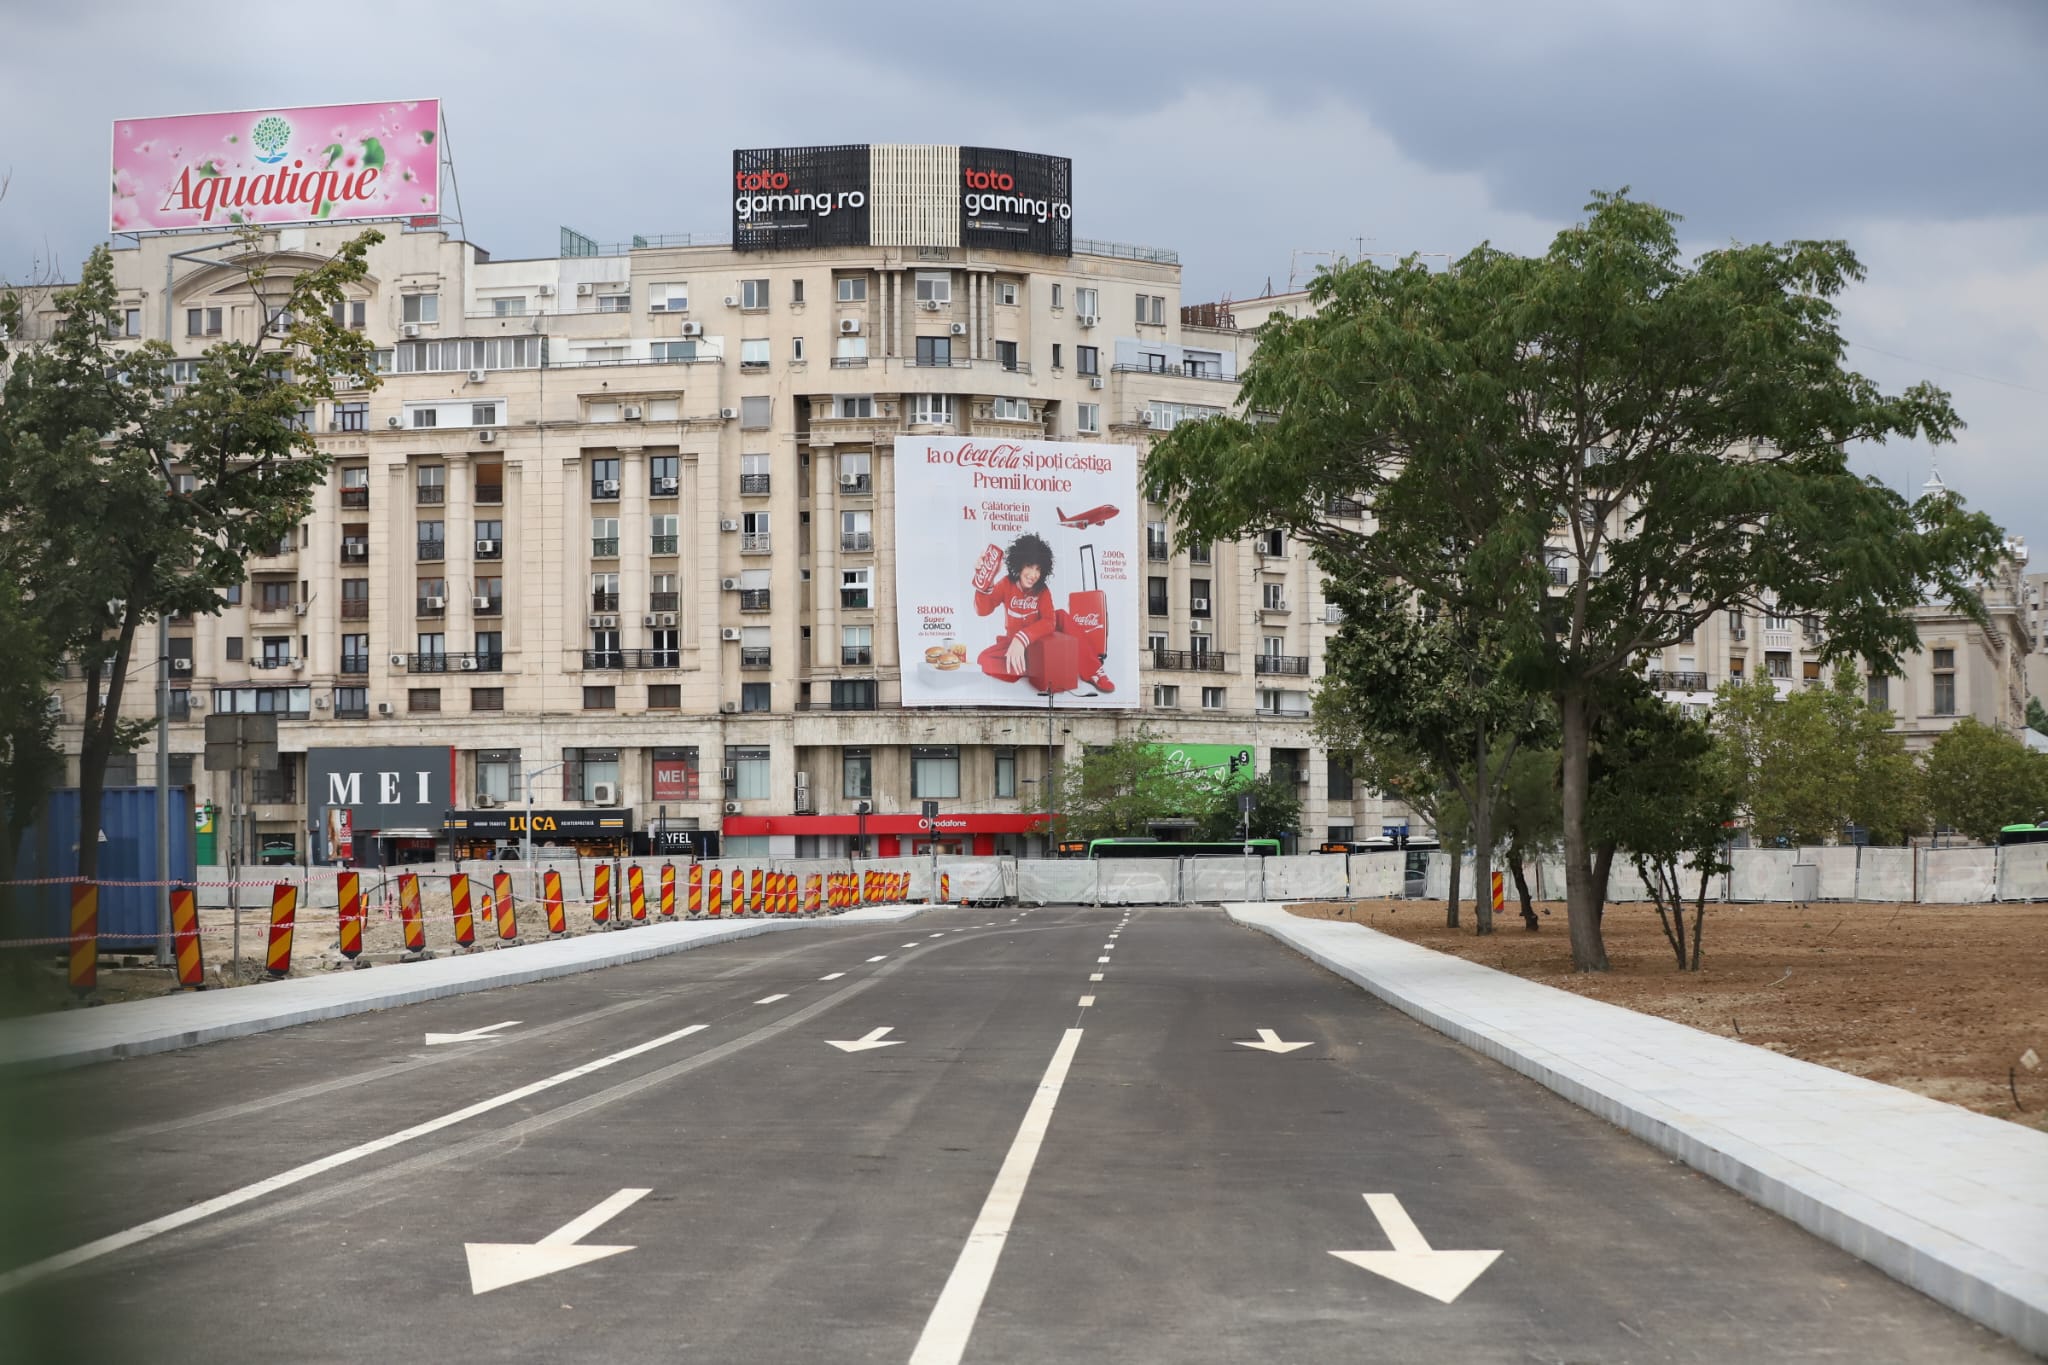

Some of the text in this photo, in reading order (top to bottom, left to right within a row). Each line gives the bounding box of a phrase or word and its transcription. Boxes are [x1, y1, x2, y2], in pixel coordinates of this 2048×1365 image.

[736, 169, 790, 191] toto
[965, 168, 1014, 191] toto
[161, 159, 379, 221] Aquatique
[736, 189, 865, 220] gaming.ro
[965, 192, 1071, 223] gaming.ro
[943, 450, 954, 464] o
[973, 472, 1072, 492] Premii Iconice
[963, 506, 977, 520] 1x
[983, 511, 989, 520] 7
[991, 521, 1023, 532] Iconice
[924, 616, 945, 624] Super
[1241, 752, 1247, 762] 5
[658, 770, 685, 783] MEI
[327, 771, 432, 805] MEI
[509, 816, 557, 831] LUCA
